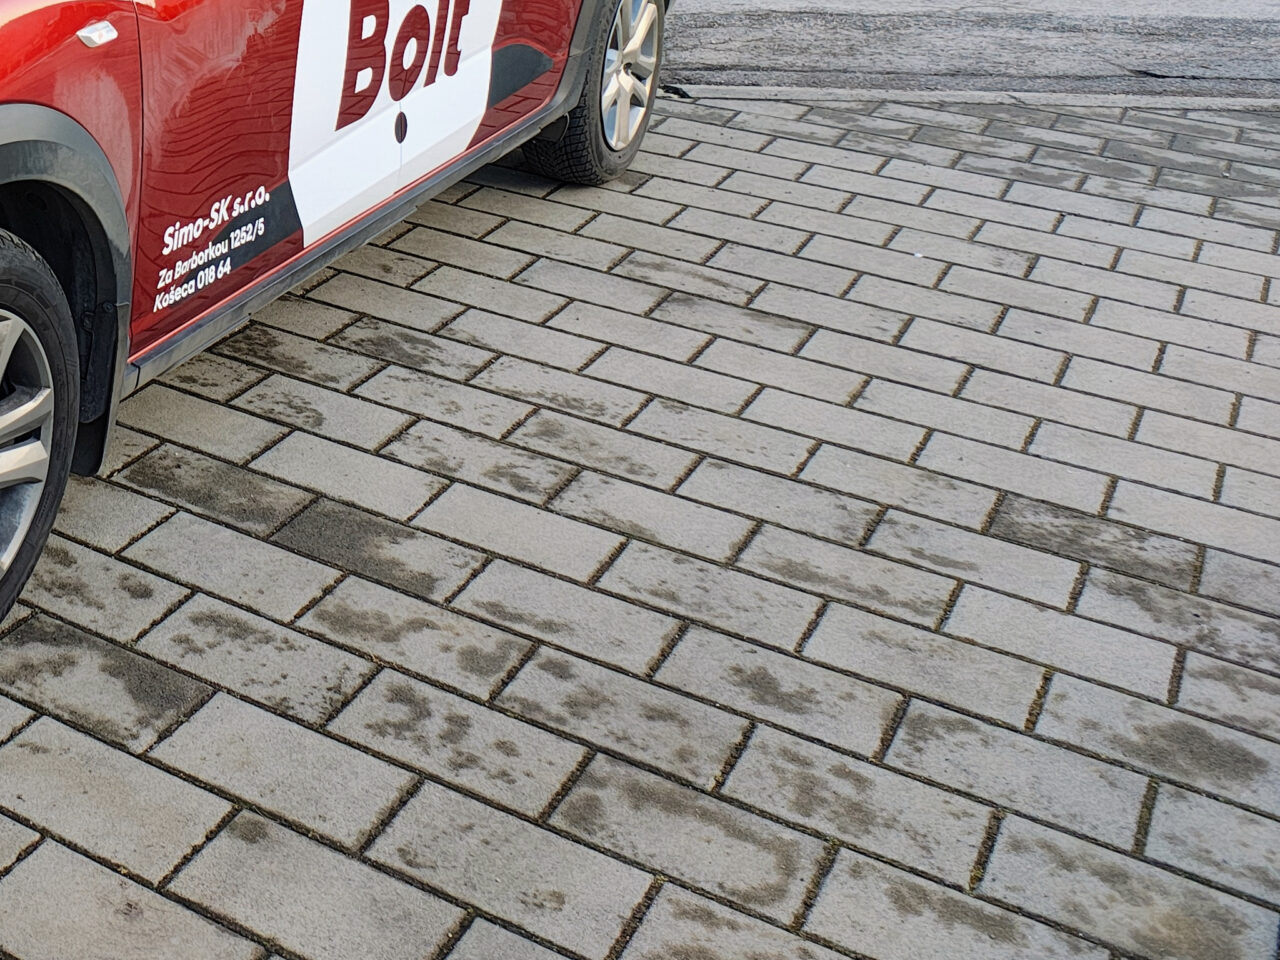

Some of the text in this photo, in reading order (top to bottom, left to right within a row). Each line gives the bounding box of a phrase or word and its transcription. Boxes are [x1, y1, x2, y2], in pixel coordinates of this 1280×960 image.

[156, 217, 265, 289] Za Barborkou 1252/5
[161, 185, 270, 256] Simo-SK s.r.o.
[153, 257, 232, 313] Košeca 018 64
